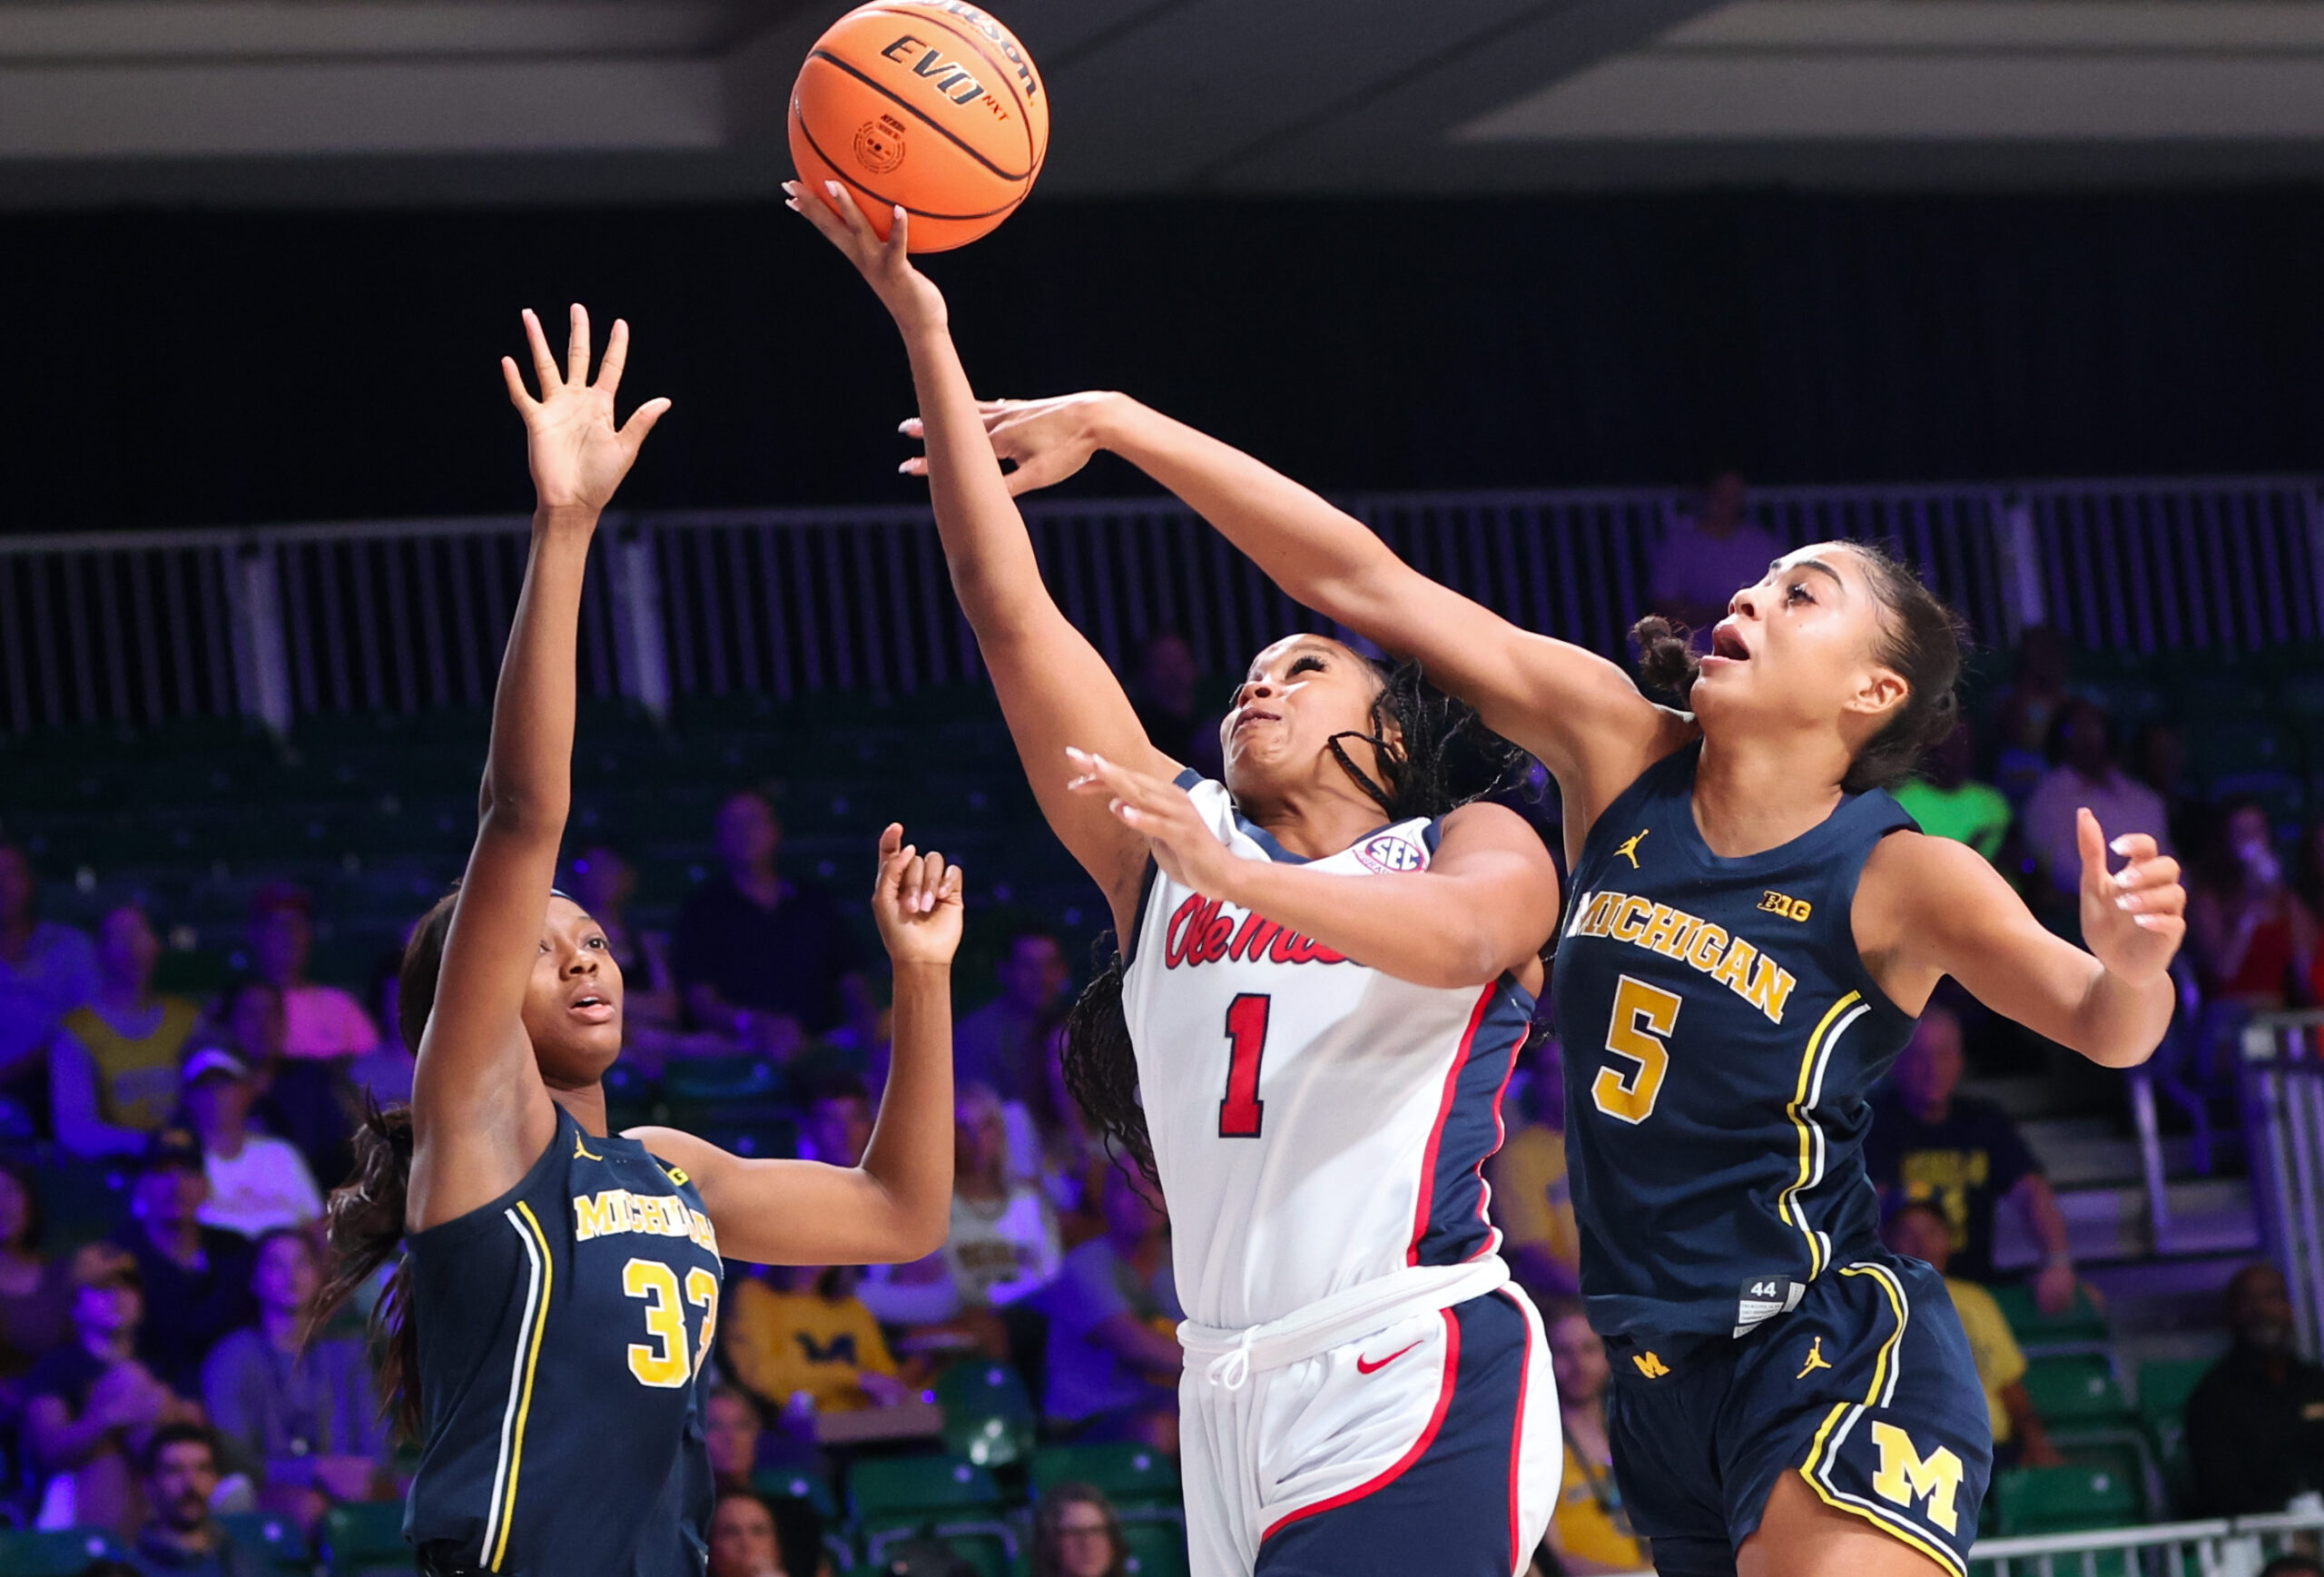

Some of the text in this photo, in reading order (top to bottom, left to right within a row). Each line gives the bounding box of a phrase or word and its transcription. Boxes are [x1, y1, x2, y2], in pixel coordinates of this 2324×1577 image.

[881, 34, 1009, 122] EVO NXT
[911, 0, 1037, 98] ilson
[1368, 836, 1422, 872] SEC
[1165, 892, 1235, 970] Ole
[1565, 891, 1797, 1025] MICHIGAN
[1218, 991, 1272, 1138] 1
[1590, 973, 1682, 1125] 5
[1750, 1281, 1777, 1297] 44
[1632, 1350, 1670, 1379] M
[1872, 1420, 1964, 1536] M
